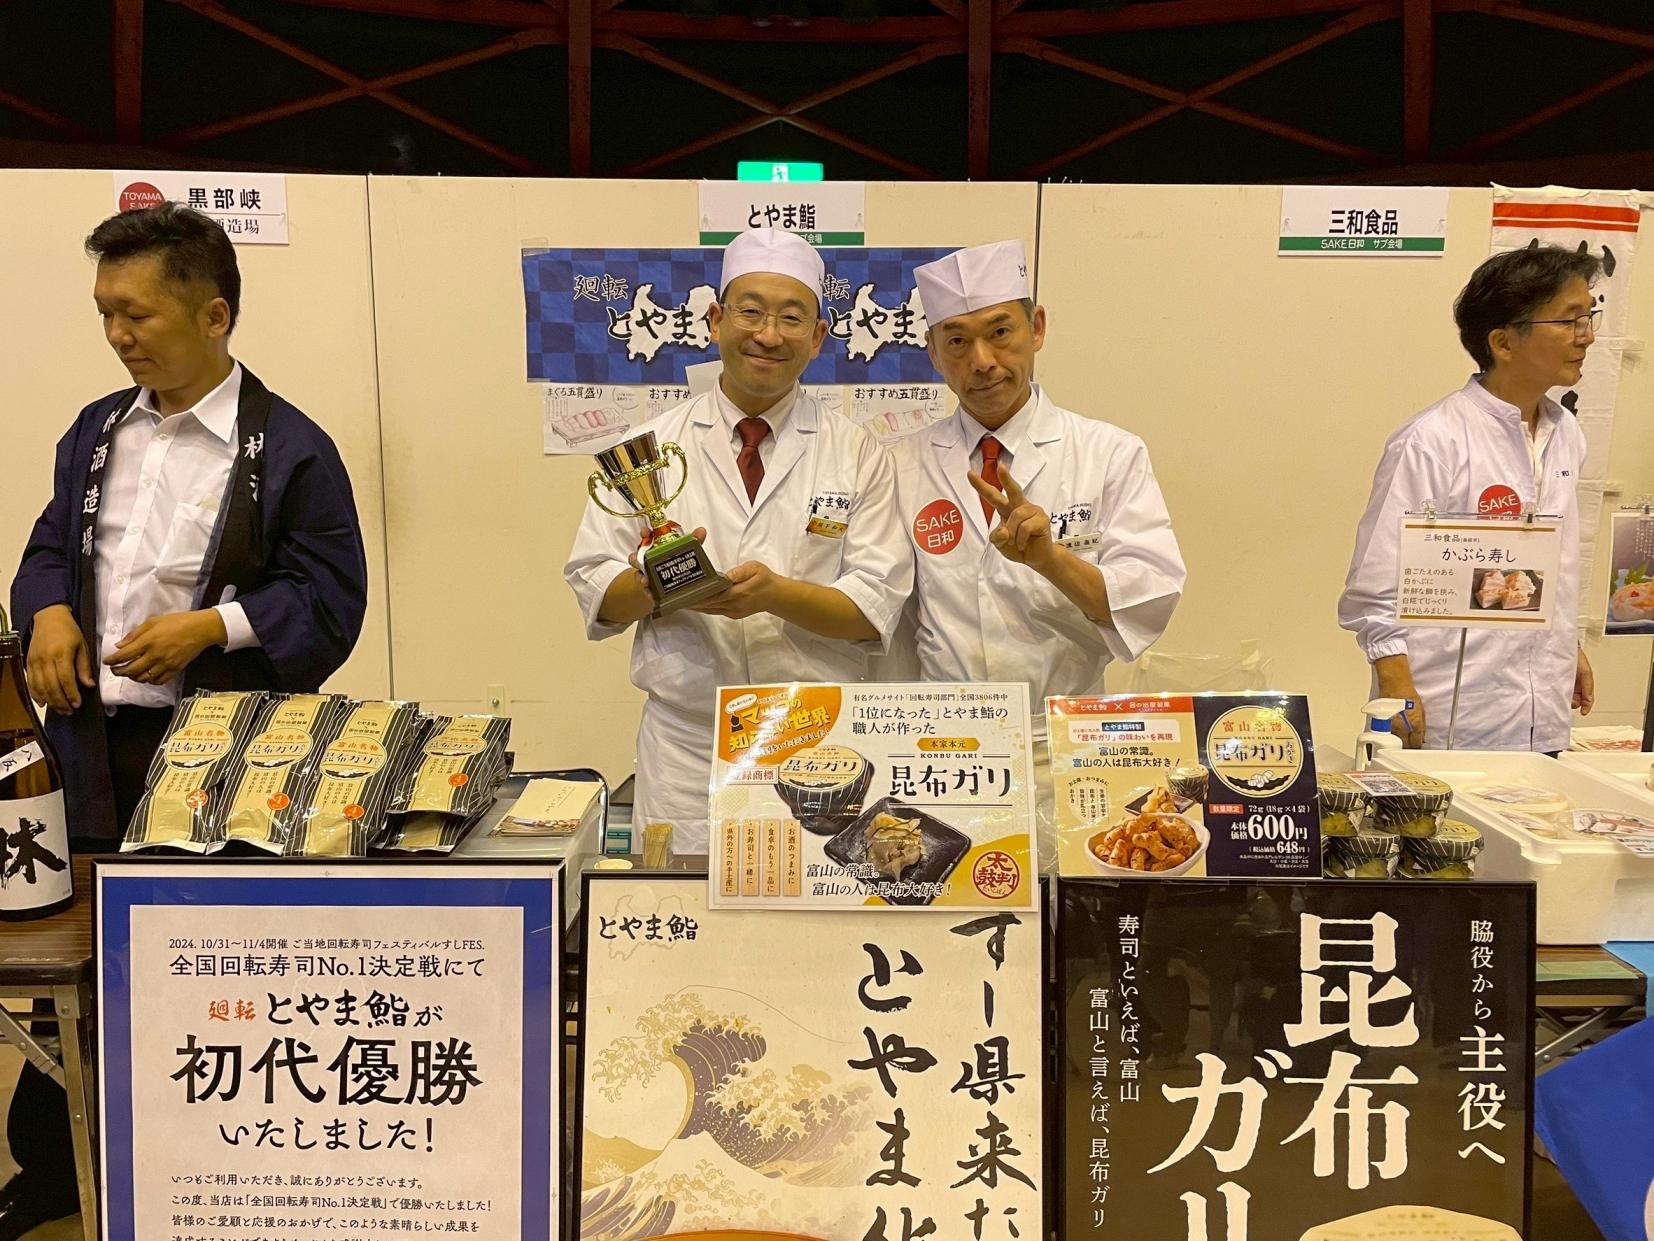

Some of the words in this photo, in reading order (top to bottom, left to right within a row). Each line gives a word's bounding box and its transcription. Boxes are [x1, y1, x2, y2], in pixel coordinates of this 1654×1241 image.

[122, 191, 162, 202] TOYAMA
[188, 188, 262, 210] 黒部峡
[747, 203, 816, 230] とやま鮨
[1329, 209, 1398, 235] 三和食品
[1320, 238, 1365, 250] SAKE日和
[1373, 238, 1403, 249] サブ会場
[574, 274, 628, 302] 廻転
[828, 303, 926, 340] とやま
[1479, 494, 1519, 513] SAKE
[916, 509, 959, 534] SAKE
[928, 532, 955, 547] 日和
[1424, 533, 1461, 543] 三和食品
[1442, 548, 1517, 564] かぶら寿し
[1405, 567, 1455, 577] 歯ごたえのある
[852, 705, 1009, 720] 「1位になった」とやま鮨の
[852, 721, 936, 735] 職人が作った
[930, 739, 966, 749] 本家本元
[1077, 733, 1174, 742] 「昆布ガリ」の味わいを再現
[1098, 746, 1155, 757] 富山の常識。
[1072, 757, 1181, 769] 富山の人は昆布大好き!
[890, 764, 1011, 798] 昆布ガリ
[1248, 804, 1264, 814] 72g
[1231, 821, 1247, 831] 本体
[1247, 814, 1308, 840] 600円
[1231, 831, 1248, 840] 価格
[788, 829, 796, 885] お酒のつまみに
[806, 863, 880, 879] 富山の常識。
[812, 881, 952, 898] 富山の人は昆布大好き!
[598, 913, 699, 942] とやま鮨
[168, 938, 198, 950] 2024.
[292, 938, 486, 952] ご当地回転寿司フェスティバルすしFES.
[169, 954, 486, 979] 全国回転寿司No.1決定戦にて
[208, 1000, 257, 1023] 廻転
[267, 989, 443, 1028] とやま鮨が
[1117, 914, 1142, 1103] 寿司といえば、富山
[1280, 911, 1420, 1190] 昆布
[1458, 919, 1508, 1165] 脇役から主役へ
[169, 1034, 484, 1106] 初代優勝
[1088, 987, 1112, 1229] 富山と言えば、昆布ガリ
[218, 1117, 434, 1154] いたしました!
[171, 1173, 423, 1189] いつもご利用いただき、誠にありがとうございます。
[171, 1194, 492, 1212] この度、当店は「全国回転寿司No.1決定戦」で優勝いたしました!
[171, 1214, 480, 1233] 皆様のご愛顧と応援のおかげで、このような素晴らしい成果を
